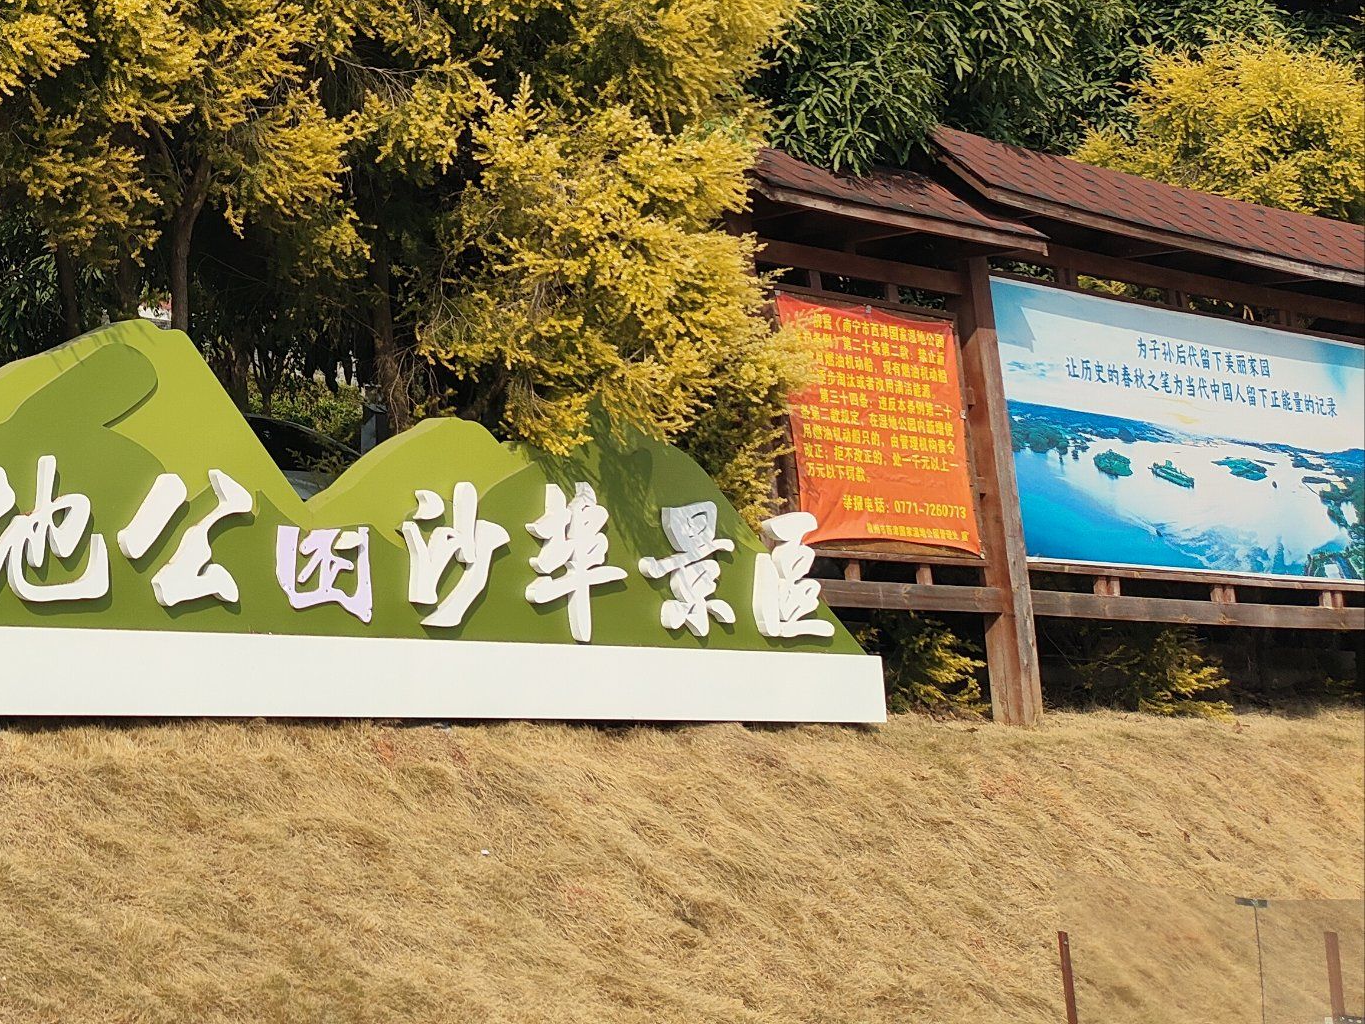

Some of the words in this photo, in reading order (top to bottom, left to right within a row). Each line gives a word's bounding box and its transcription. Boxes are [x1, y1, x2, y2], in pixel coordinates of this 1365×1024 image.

[1137, 337, 1271, 378] 为子孙后代留下美丽家园
[1065, 356, 1338, 417] 让历史的春秋之笔为当代中国人留下正能量的记录
